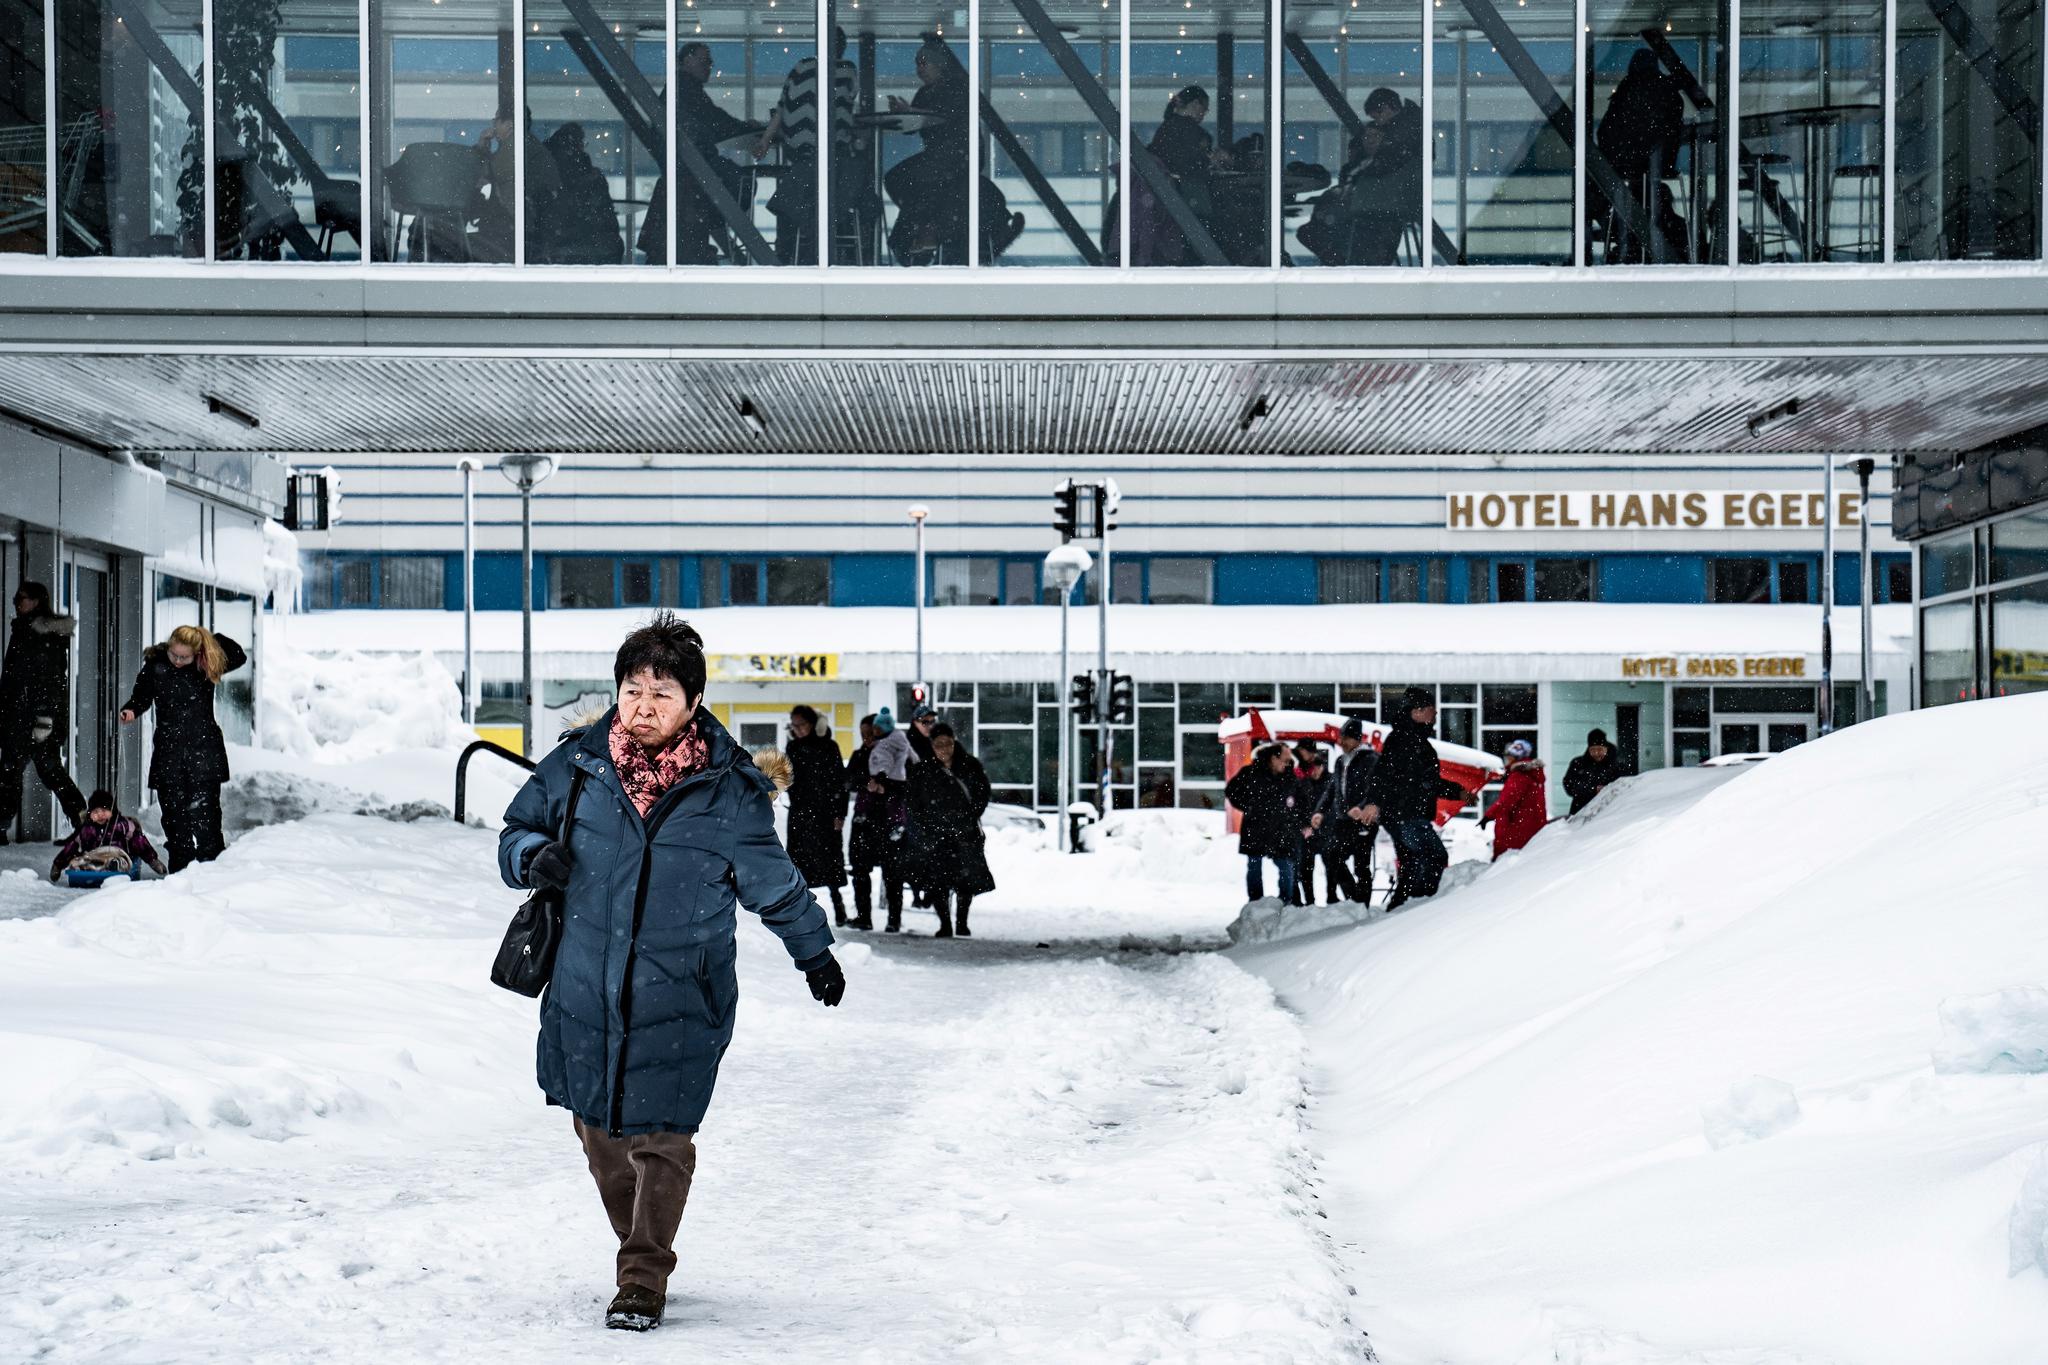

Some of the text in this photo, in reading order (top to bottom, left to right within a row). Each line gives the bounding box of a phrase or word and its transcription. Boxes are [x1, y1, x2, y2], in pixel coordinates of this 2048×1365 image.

[1449, 492, 1861, 528] HOTEL HANS EGEDE
[1621, 656, 1806, 677] HOTEL HANS EGEDE
